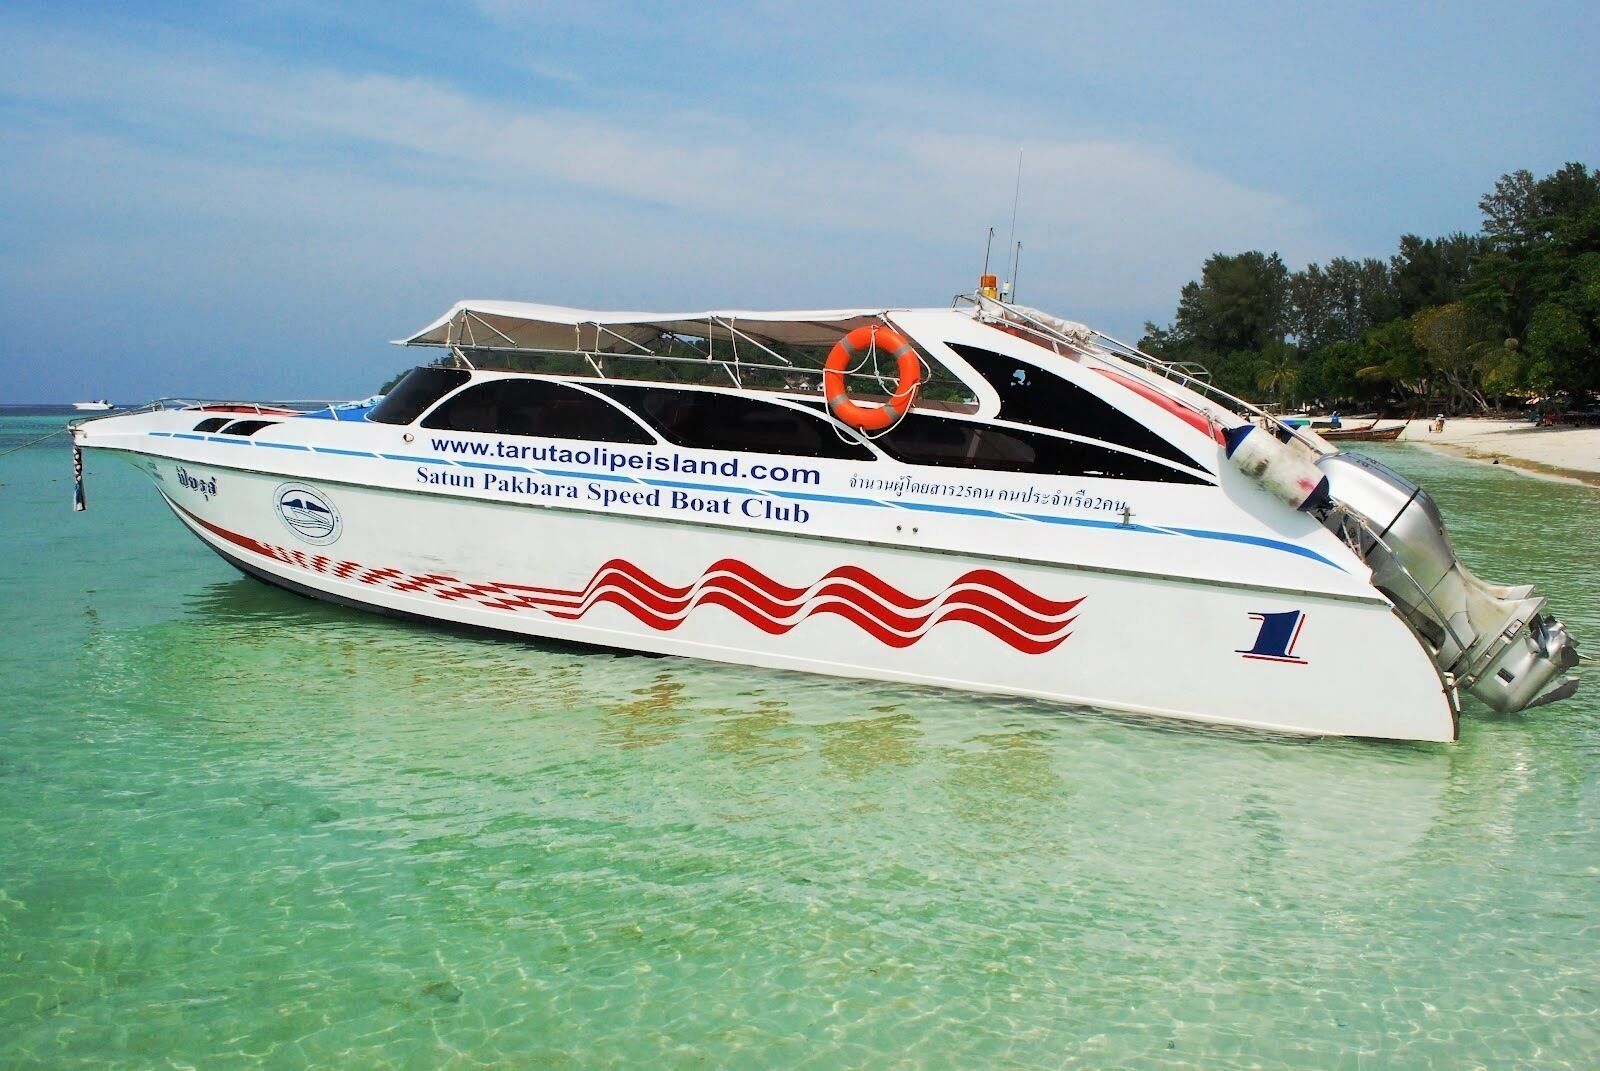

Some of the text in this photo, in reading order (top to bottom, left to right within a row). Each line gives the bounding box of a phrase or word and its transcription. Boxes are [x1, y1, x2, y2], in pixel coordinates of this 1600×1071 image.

[431, 438, 820, 485] www.tarutaolipeisland.com
[848, 472, 994, 499] จำนวนผู้โดยสาร25คน
[417, 466, 810, 524] Satun Pakbara Speed Boat Club
[1234, 610, 1308, 664] 1
